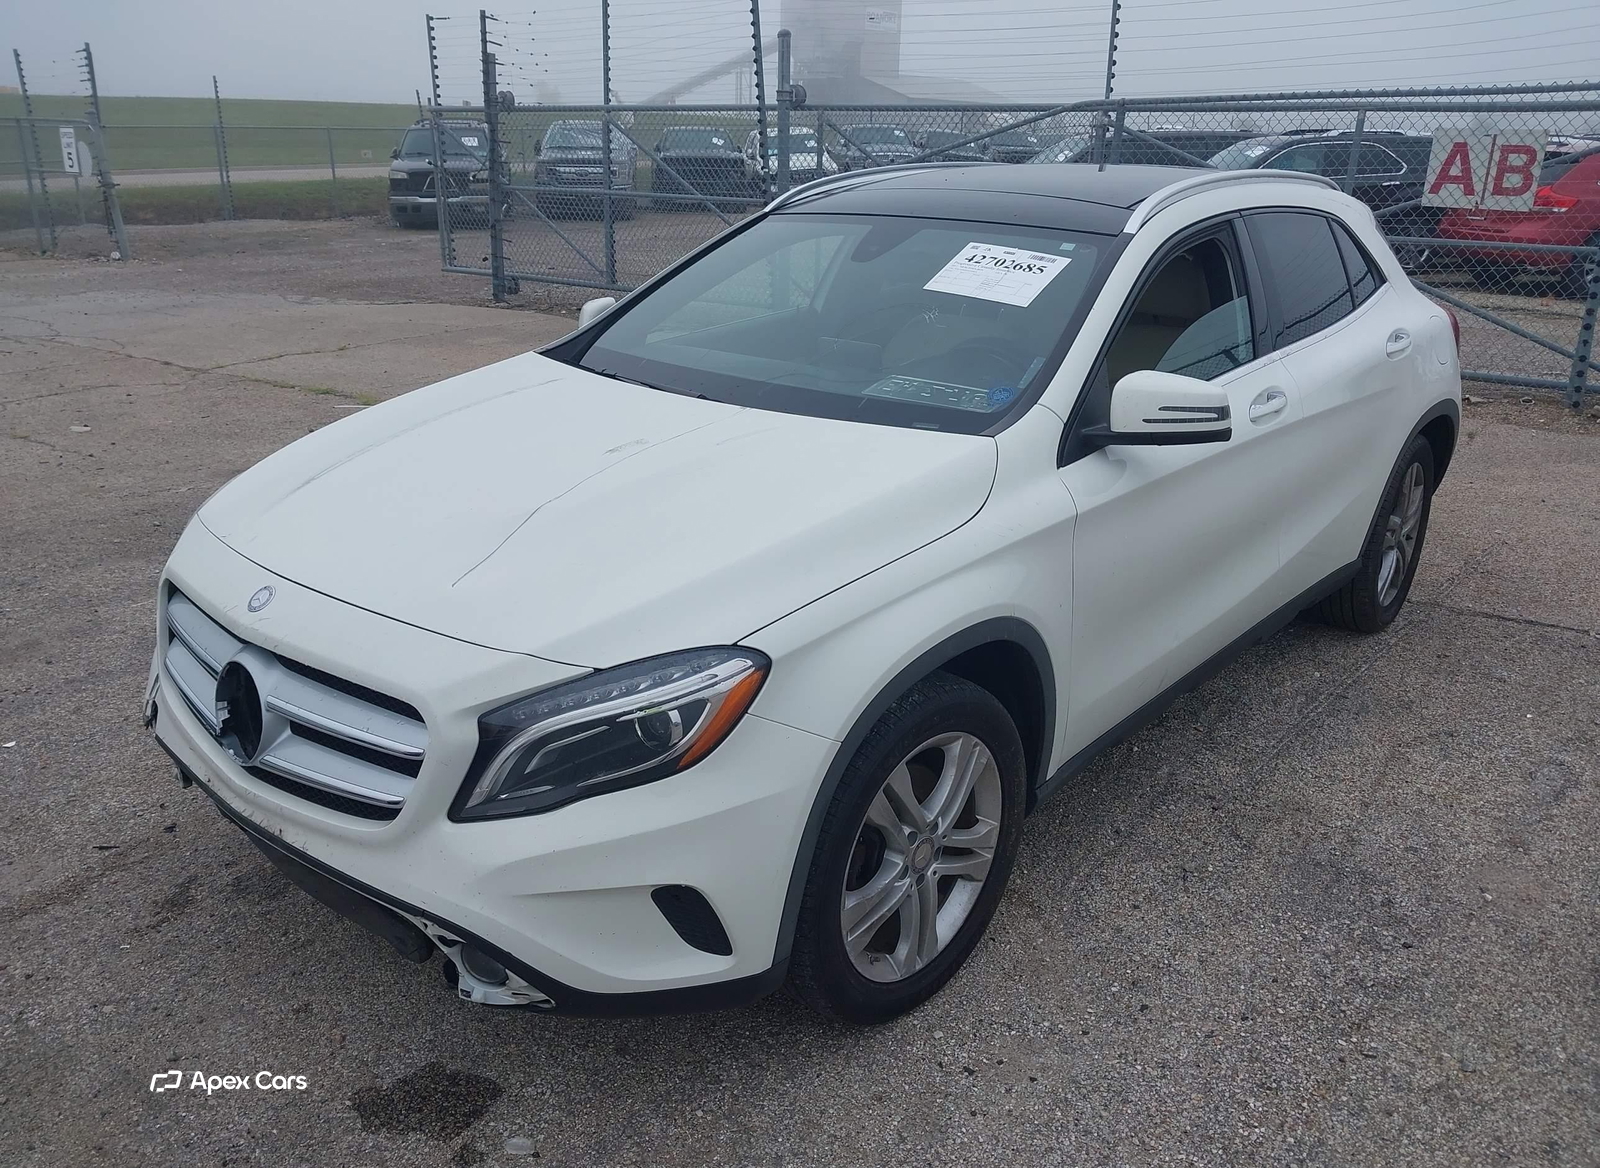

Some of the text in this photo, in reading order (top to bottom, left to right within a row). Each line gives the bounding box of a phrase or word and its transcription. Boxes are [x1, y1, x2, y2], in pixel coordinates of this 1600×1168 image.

[67, 151, 75, 169] 5
[1428, 141, 1538, 197] A B
[965, 253, 1048, 276] 42702685
